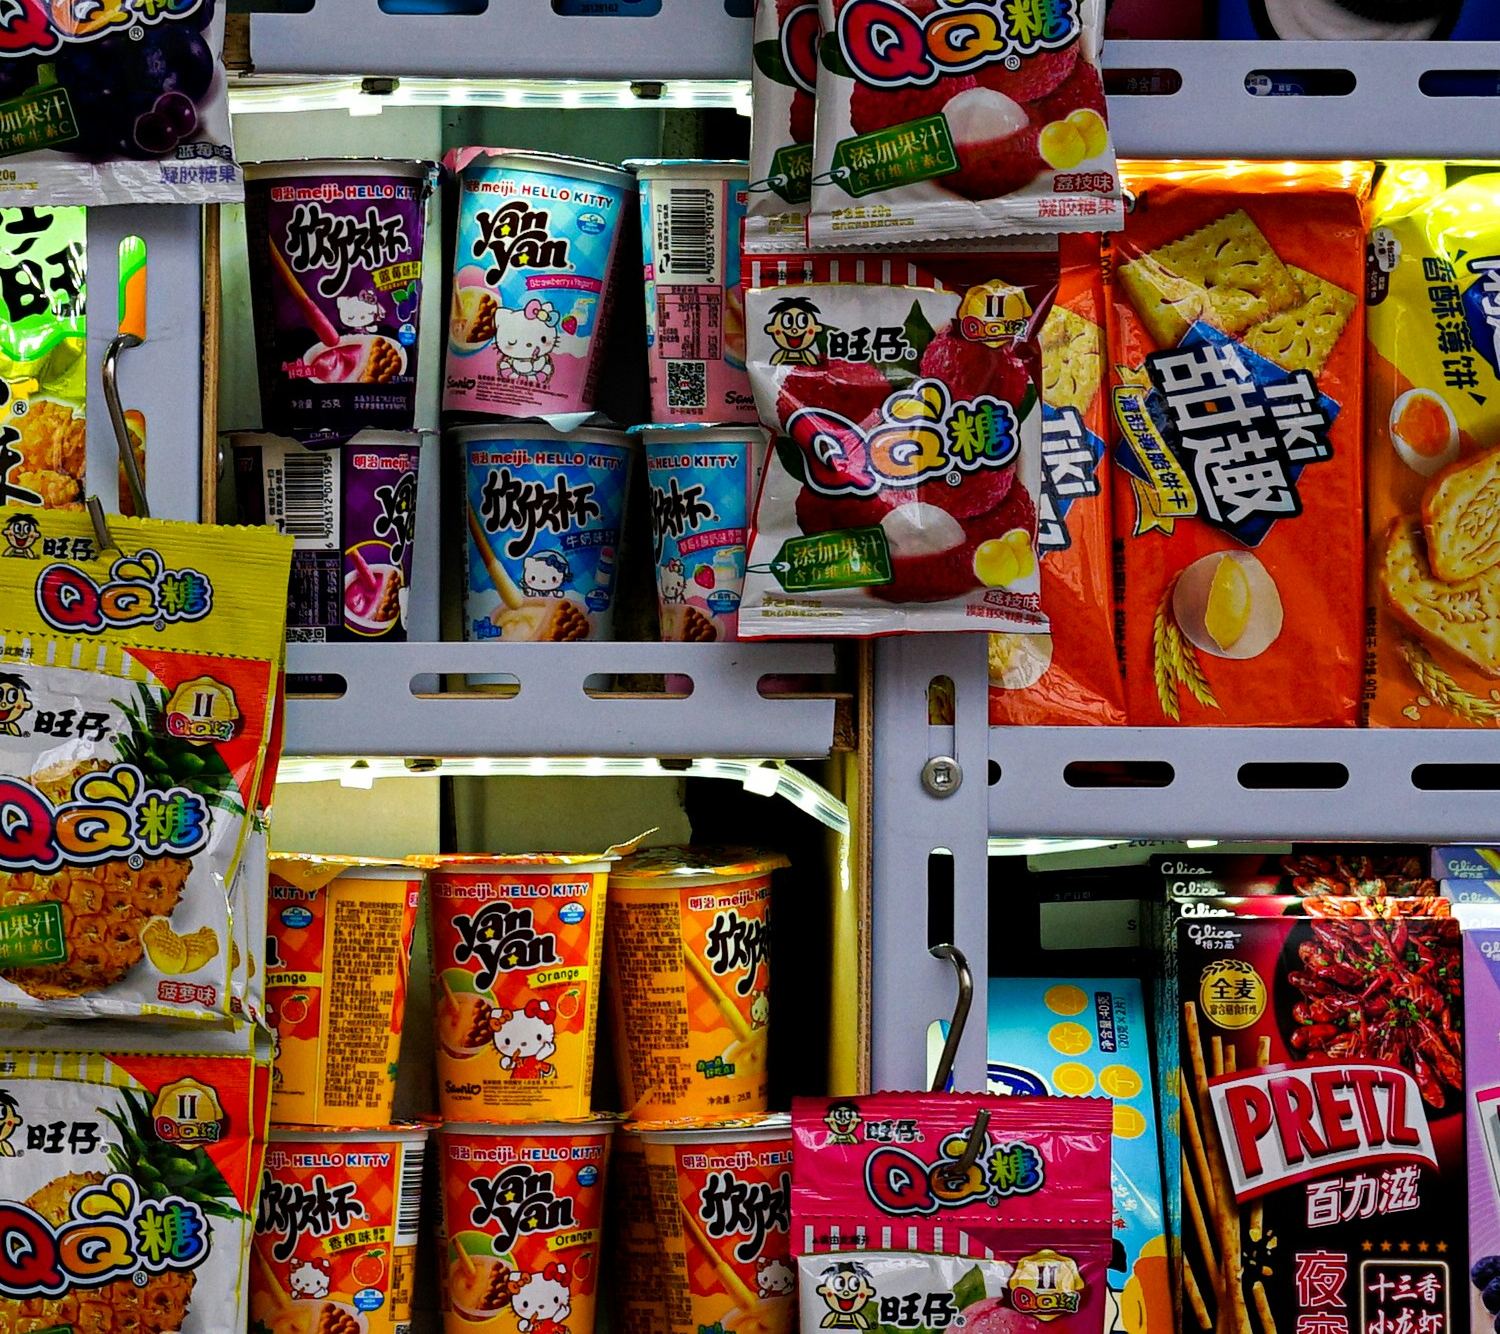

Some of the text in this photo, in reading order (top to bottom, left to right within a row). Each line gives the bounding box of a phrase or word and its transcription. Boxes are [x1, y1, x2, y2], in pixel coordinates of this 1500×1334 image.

[1425, 257, 1481, 391] 香酥薄饼
[537, 968, 579, 983] Orange
[159, 981, 216, 1005] 菠萝味
[1222, 1071, 1419, 1178] PRETZ
[1306, 1166, 1421, 1228] 百力滋
[328, 1229, 372, 1250] 香橙味
[1369, 1274, 1441, 1302] 十三香
